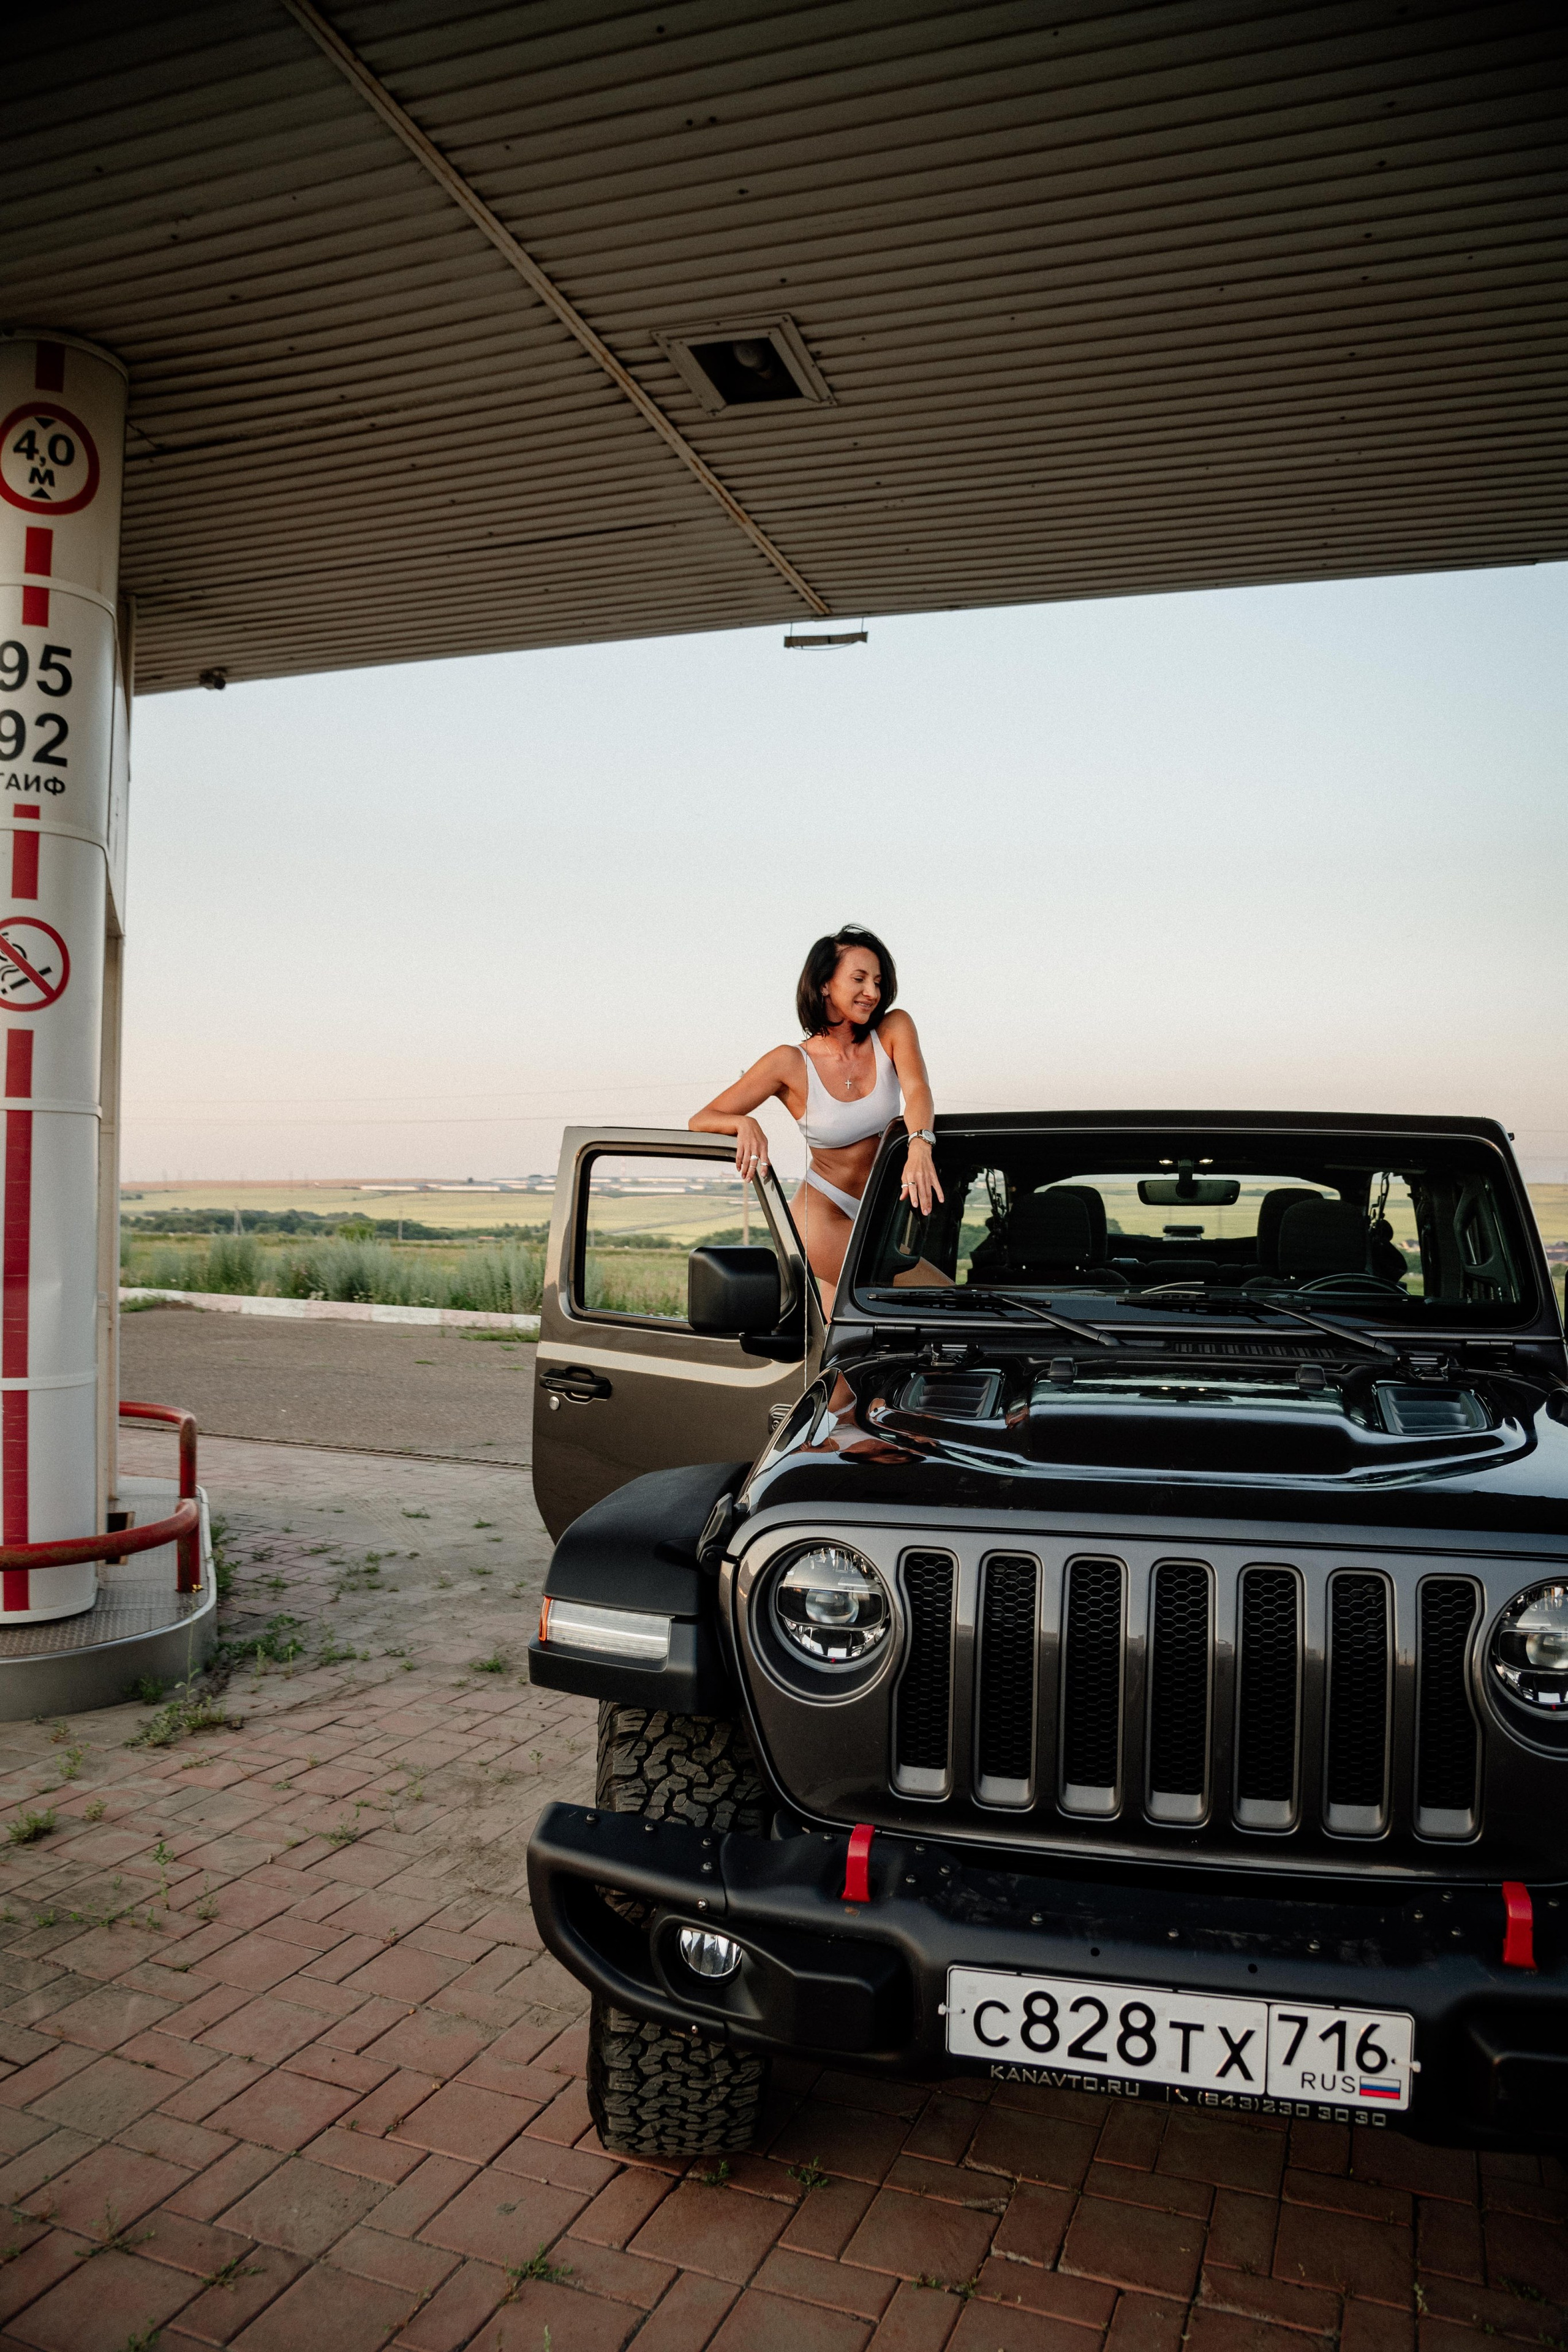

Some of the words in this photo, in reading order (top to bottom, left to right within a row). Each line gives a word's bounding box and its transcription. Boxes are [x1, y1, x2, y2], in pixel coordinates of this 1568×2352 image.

[13, 429, 75, 467] 4,0
[0, 640, 72, 698] 95
[0, 709, 69, 768] 92
[1278, 2013, 1389, 2074] 716
[990, 2065, 1140, 2097] KANAVTO.RU
[1301, 2071, 1356, 2094] RUS
